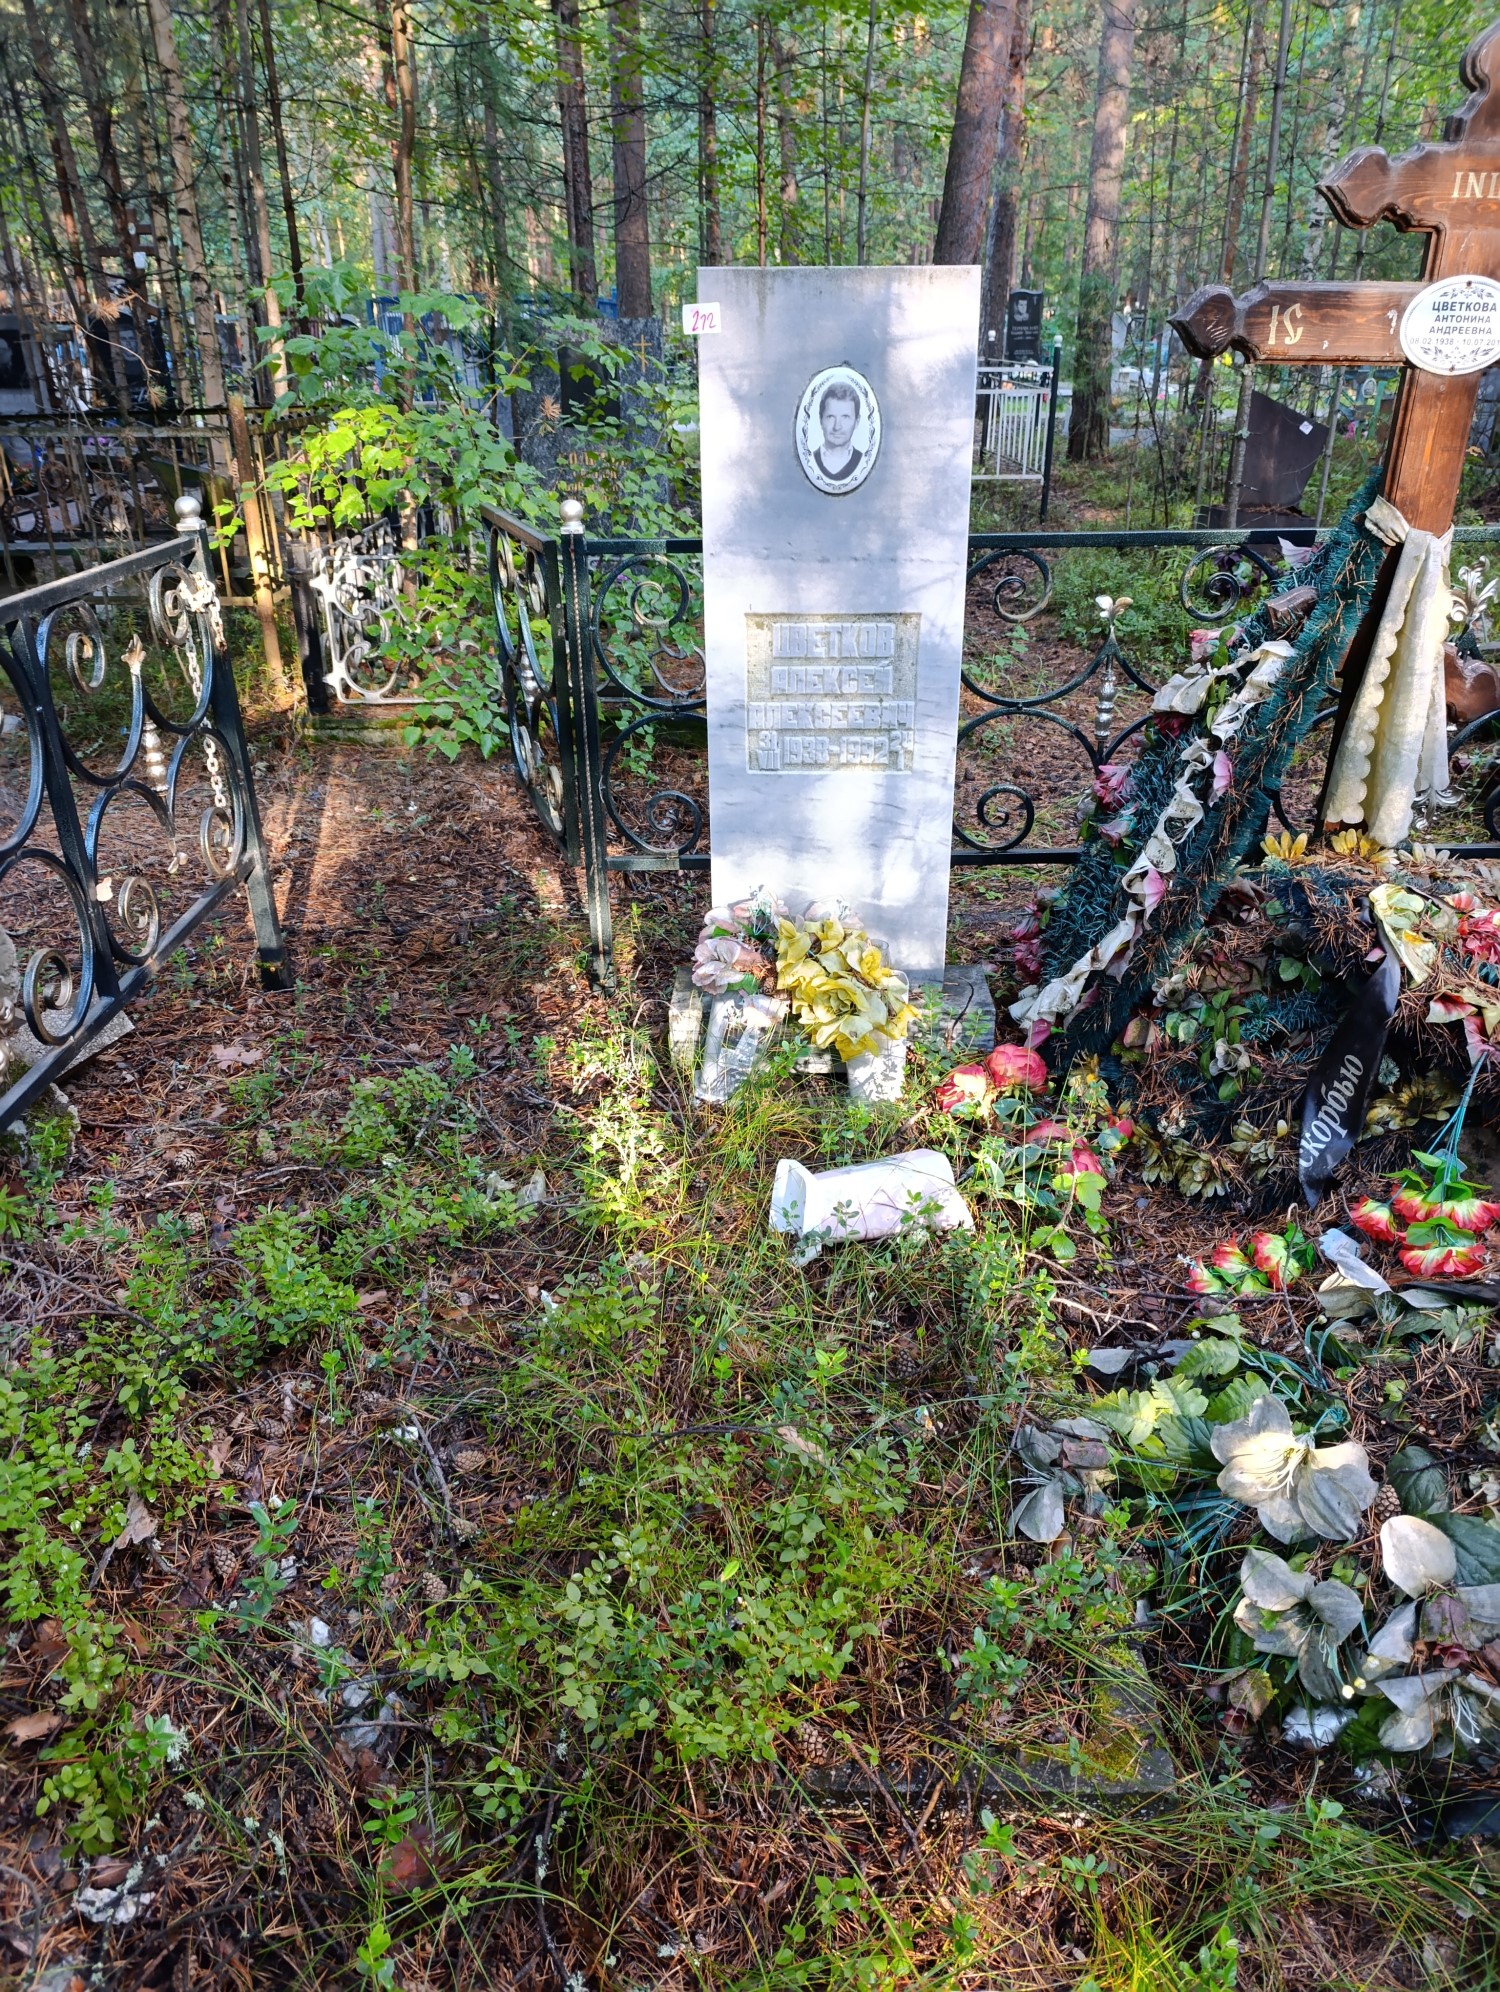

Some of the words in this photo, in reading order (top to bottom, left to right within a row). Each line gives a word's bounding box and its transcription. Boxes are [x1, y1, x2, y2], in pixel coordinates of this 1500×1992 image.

[1432, 301, 1497, 313] ЦВЕТКОВА
[1434, 314, 1491, 324] АНТОНИНА
[1429, 326, 1492, 335] АНДРЕЕВНА
[1463, 338, 1500, 346] 10.07.201
[772, 623, 896, 658] ЦВЕТКОВ
[771, 660, 893, 695] АЛЕКСЕЙ
[748, 702, 915, 729] АЛЕКСЕЕВИЧ
[1299, 1054, 1364, 1168] скорбью
